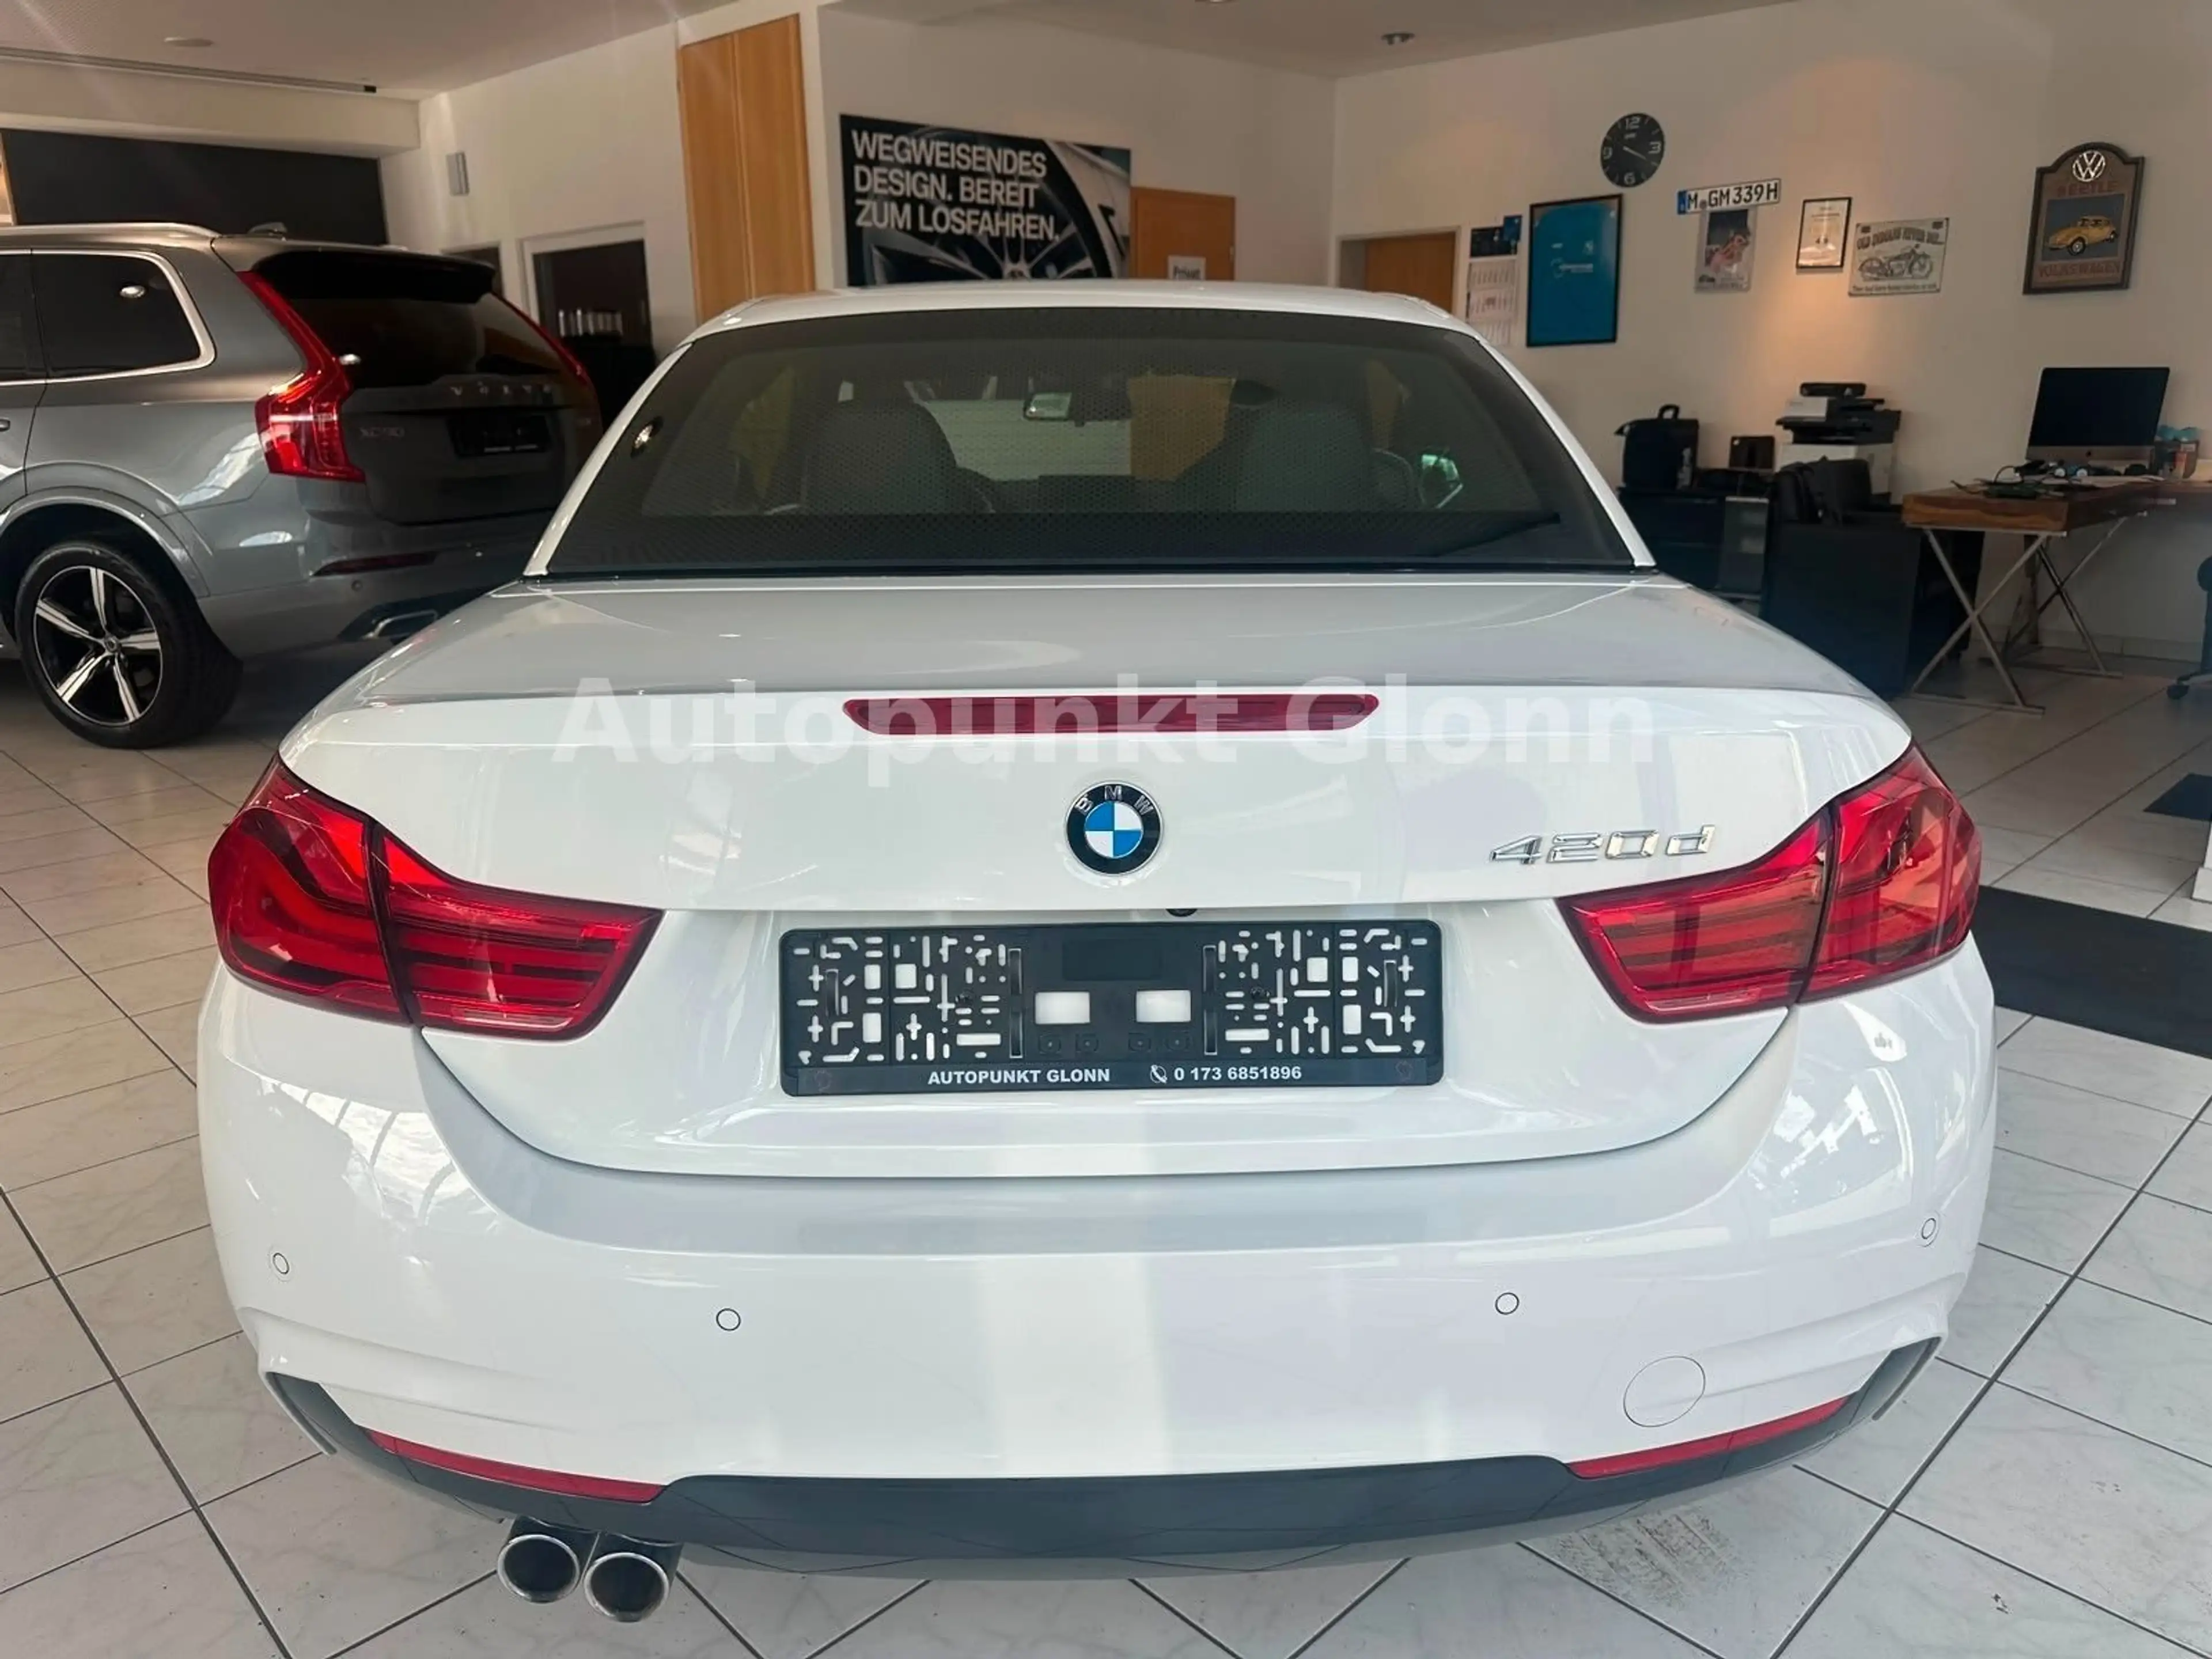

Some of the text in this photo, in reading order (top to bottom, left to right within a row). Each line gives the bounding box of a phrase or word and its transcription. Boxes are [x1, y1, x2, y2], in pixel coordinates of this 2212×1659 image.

[1625, 116, 1640, 130] 12
[851, 129, 1047, 178] WEGWEISENDES
[1603, 146, 1612, 160] 9
[1648, 141, 1661, 154] 3
[853, 165, 1040, 209] DESIGN. BEREIT
[1624, 172, 1635, 185] 6
[855, 198, 1060, 243] ZUM LOSFAHREN.
[1074, 785, 1154, 816] BMW
[1488, 824, 1716, 866] 420d
[928, 1066, 1302, 1085] AUTOPUNKT GLONN 0 173 6851896
